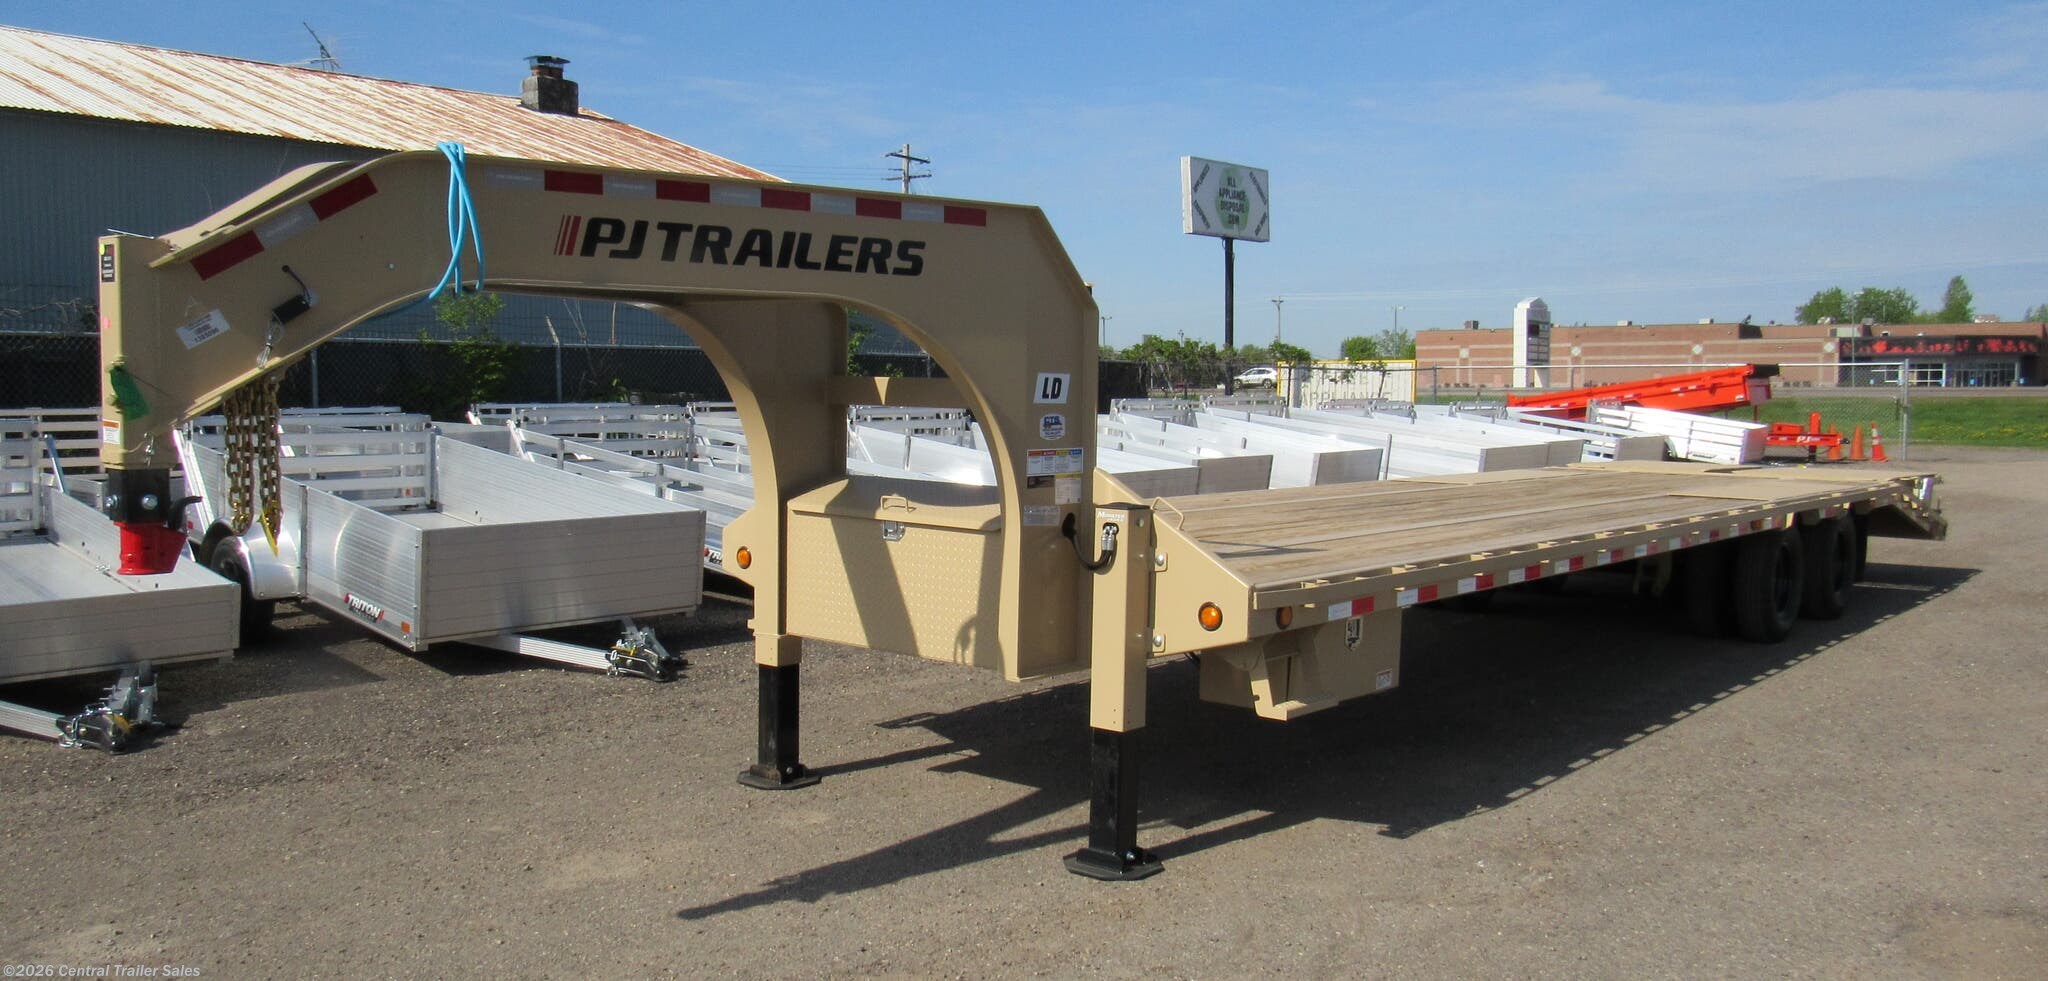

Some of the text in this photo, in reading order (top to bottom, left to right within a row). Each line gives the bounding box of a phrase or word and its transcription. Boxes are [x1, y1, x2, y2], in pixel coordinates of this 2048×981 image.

[580, 217, 926, 276] PJ TRAILERS
[1042, 377, 1062, 399] LD
[348, 594, 381, 618] TRITON
